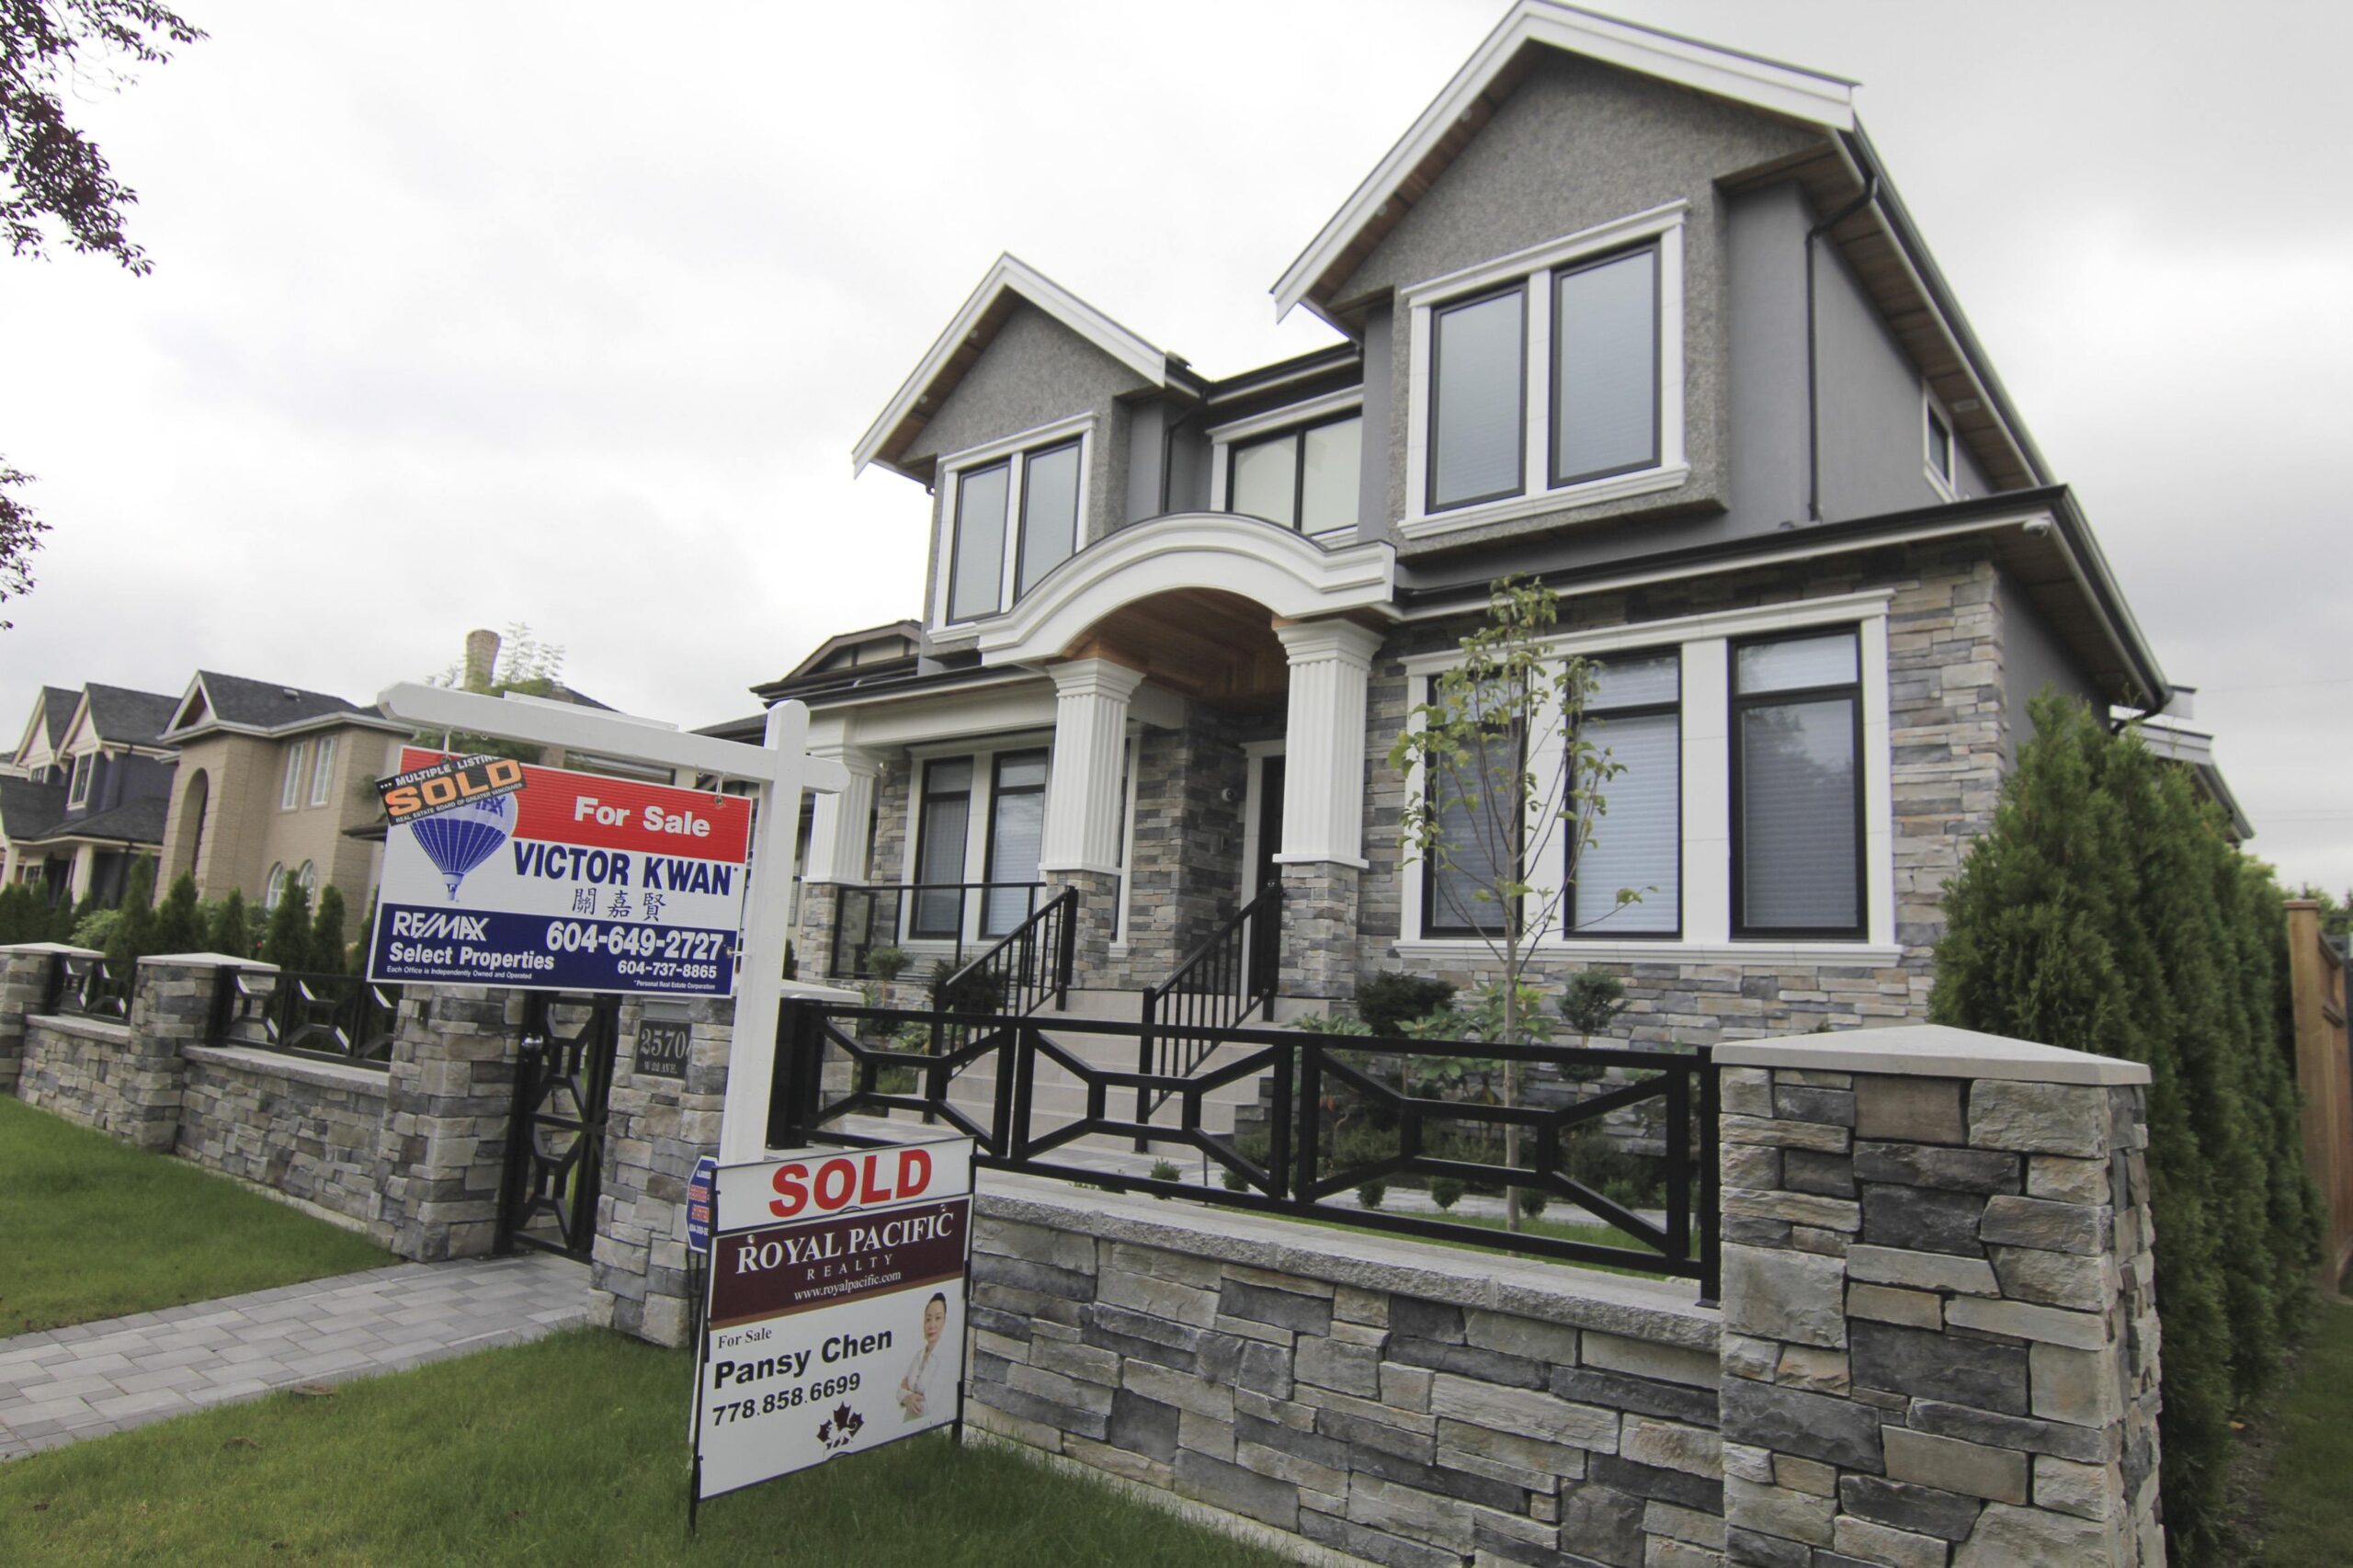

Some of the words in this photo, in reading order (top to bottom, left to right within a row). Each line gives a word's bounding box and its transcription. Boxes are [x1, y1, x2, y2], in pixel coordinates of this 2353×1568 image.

[385, 759, 522, 816] SOLD
[395, 764, 451, 787] MULTIPLE
[456, 755, 503, 770] LISTIN
[395, 815, 412, 824] REAL
[413, 808, 435, 818] ESTATE
[436, 801, 455, 812] BOARD
[465, 792, 492, 803] GREATER
[492, 782, 522, 797] VANCOUVER
[574, 795, 631, 826] For
[642, 805, 710, 837] Sale
[514, 841, 631, 886] VICTOR
[392, 911, 489, 941] RE/MAX
[546, 920, 724, 961] 604-649-2727
[387, 965, 402, 973] Each
[404, 966, 422, 974] Office
[431, 968, 471, 977] Independently
[506, 971, 532, 980] Operated
[390, 942, 452, 965] Select
[460, 946, 555, 971] Properties
[618, 960, 717, 980] 604-737-8865
[640, 1028, 687, 1059] 2570
[768, 1149, 932, 1218] SOLD
[735, 1233, 841, 1274] ROYAL
[847, 1212, 954, 1255] PACIFIC
[807, 1254, 893, 1280] REALTY
[794, 1271, 901, 1301] www.royalpacific.com
[718, 1335, 743, 1349] For
[745, 1328, 772, 1344] Sale
[714, 1349, 812, 1390] Pansy
[821, 1329, 892, 1364] Chen
[712, 1372, 860, 1426] 778.858.6699
